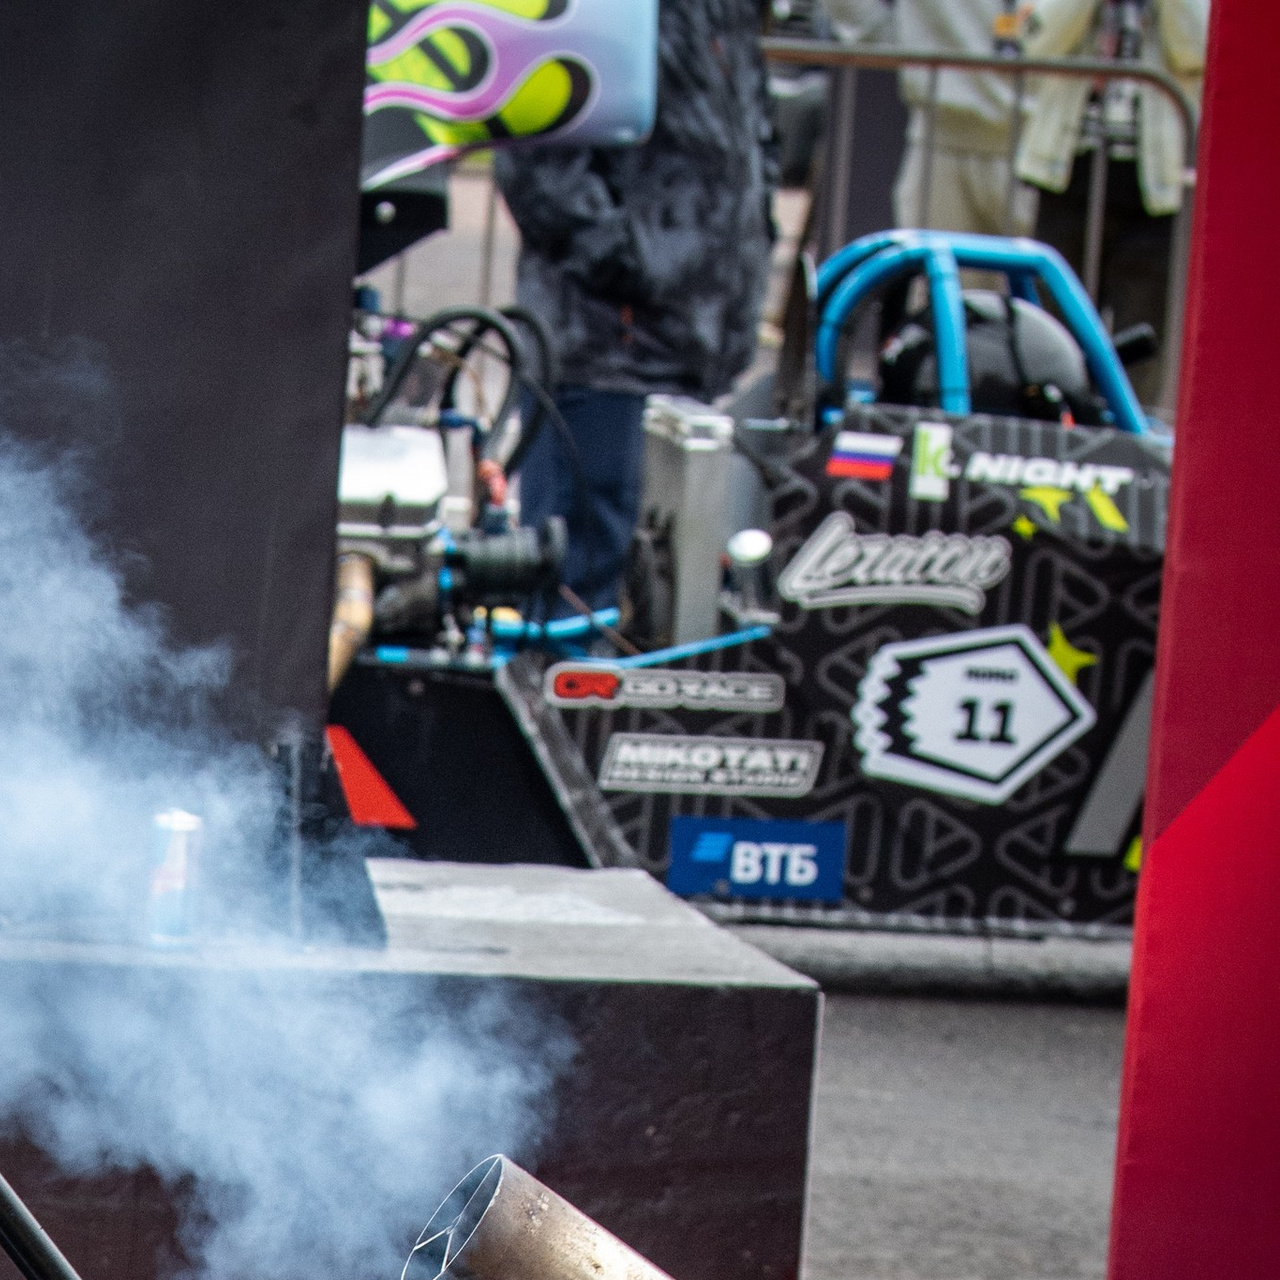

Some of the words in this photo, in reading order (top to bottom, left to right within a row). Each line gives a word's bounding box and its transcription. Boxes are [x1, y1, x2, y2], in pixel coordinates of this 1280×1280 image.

[967, 452, 1134, 494] NIGHT
[955, 698, 1015, 744] 11
[731, 841, 818, 886] ВТБ
